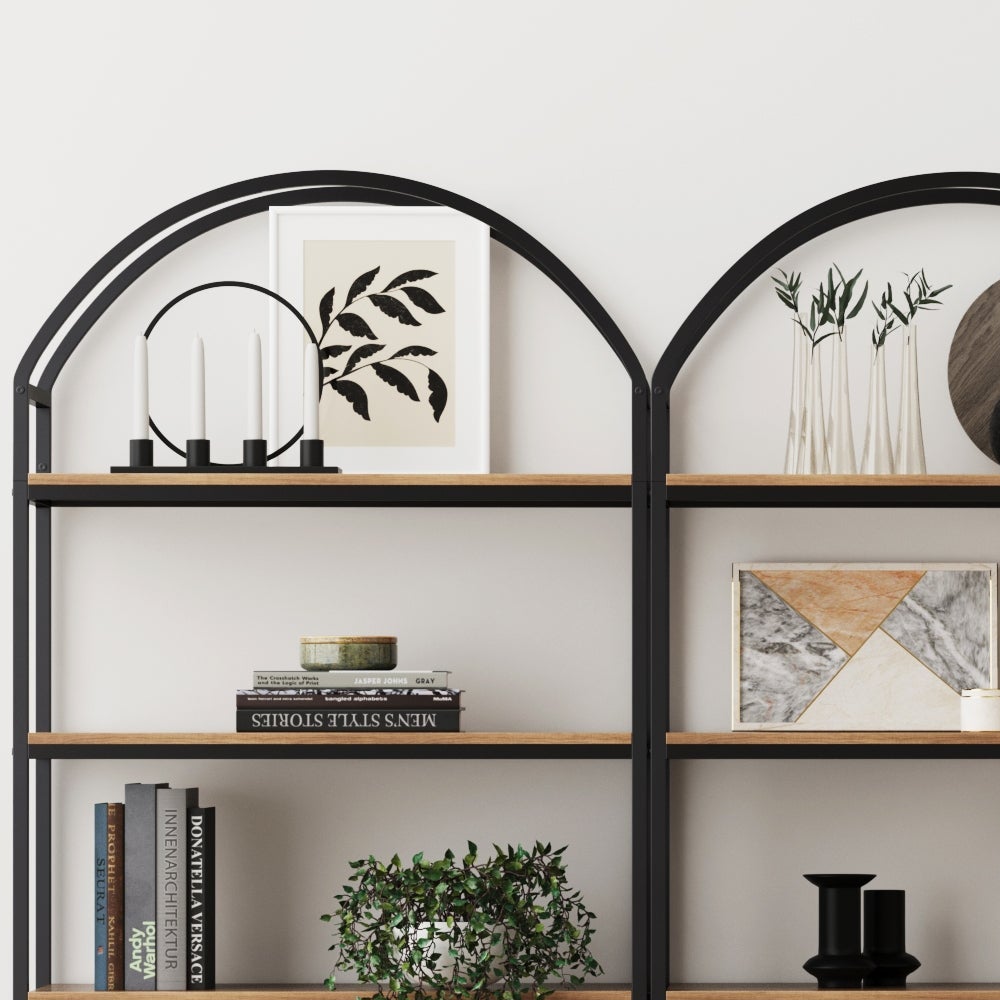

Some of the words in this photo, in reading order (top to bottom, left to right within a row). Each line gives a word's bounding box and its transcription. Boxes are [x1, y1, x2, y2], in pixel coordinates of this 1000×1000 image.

[252, 713, 323, 728] STORIES
[327, 713, 380, 728] STYLE
[384, 713, 436, 728] MEN'S
[96, 858, 106, 926] SEURAT
[164, 809, 178, 970] INNENARCHITEKTUR
[191, 816, 202, 908] DONATELLA
[128, 928, 146, 972] Andy
[142, 920, 156, 980] Warhol
[191, 912, 202, 984] VERSACE
